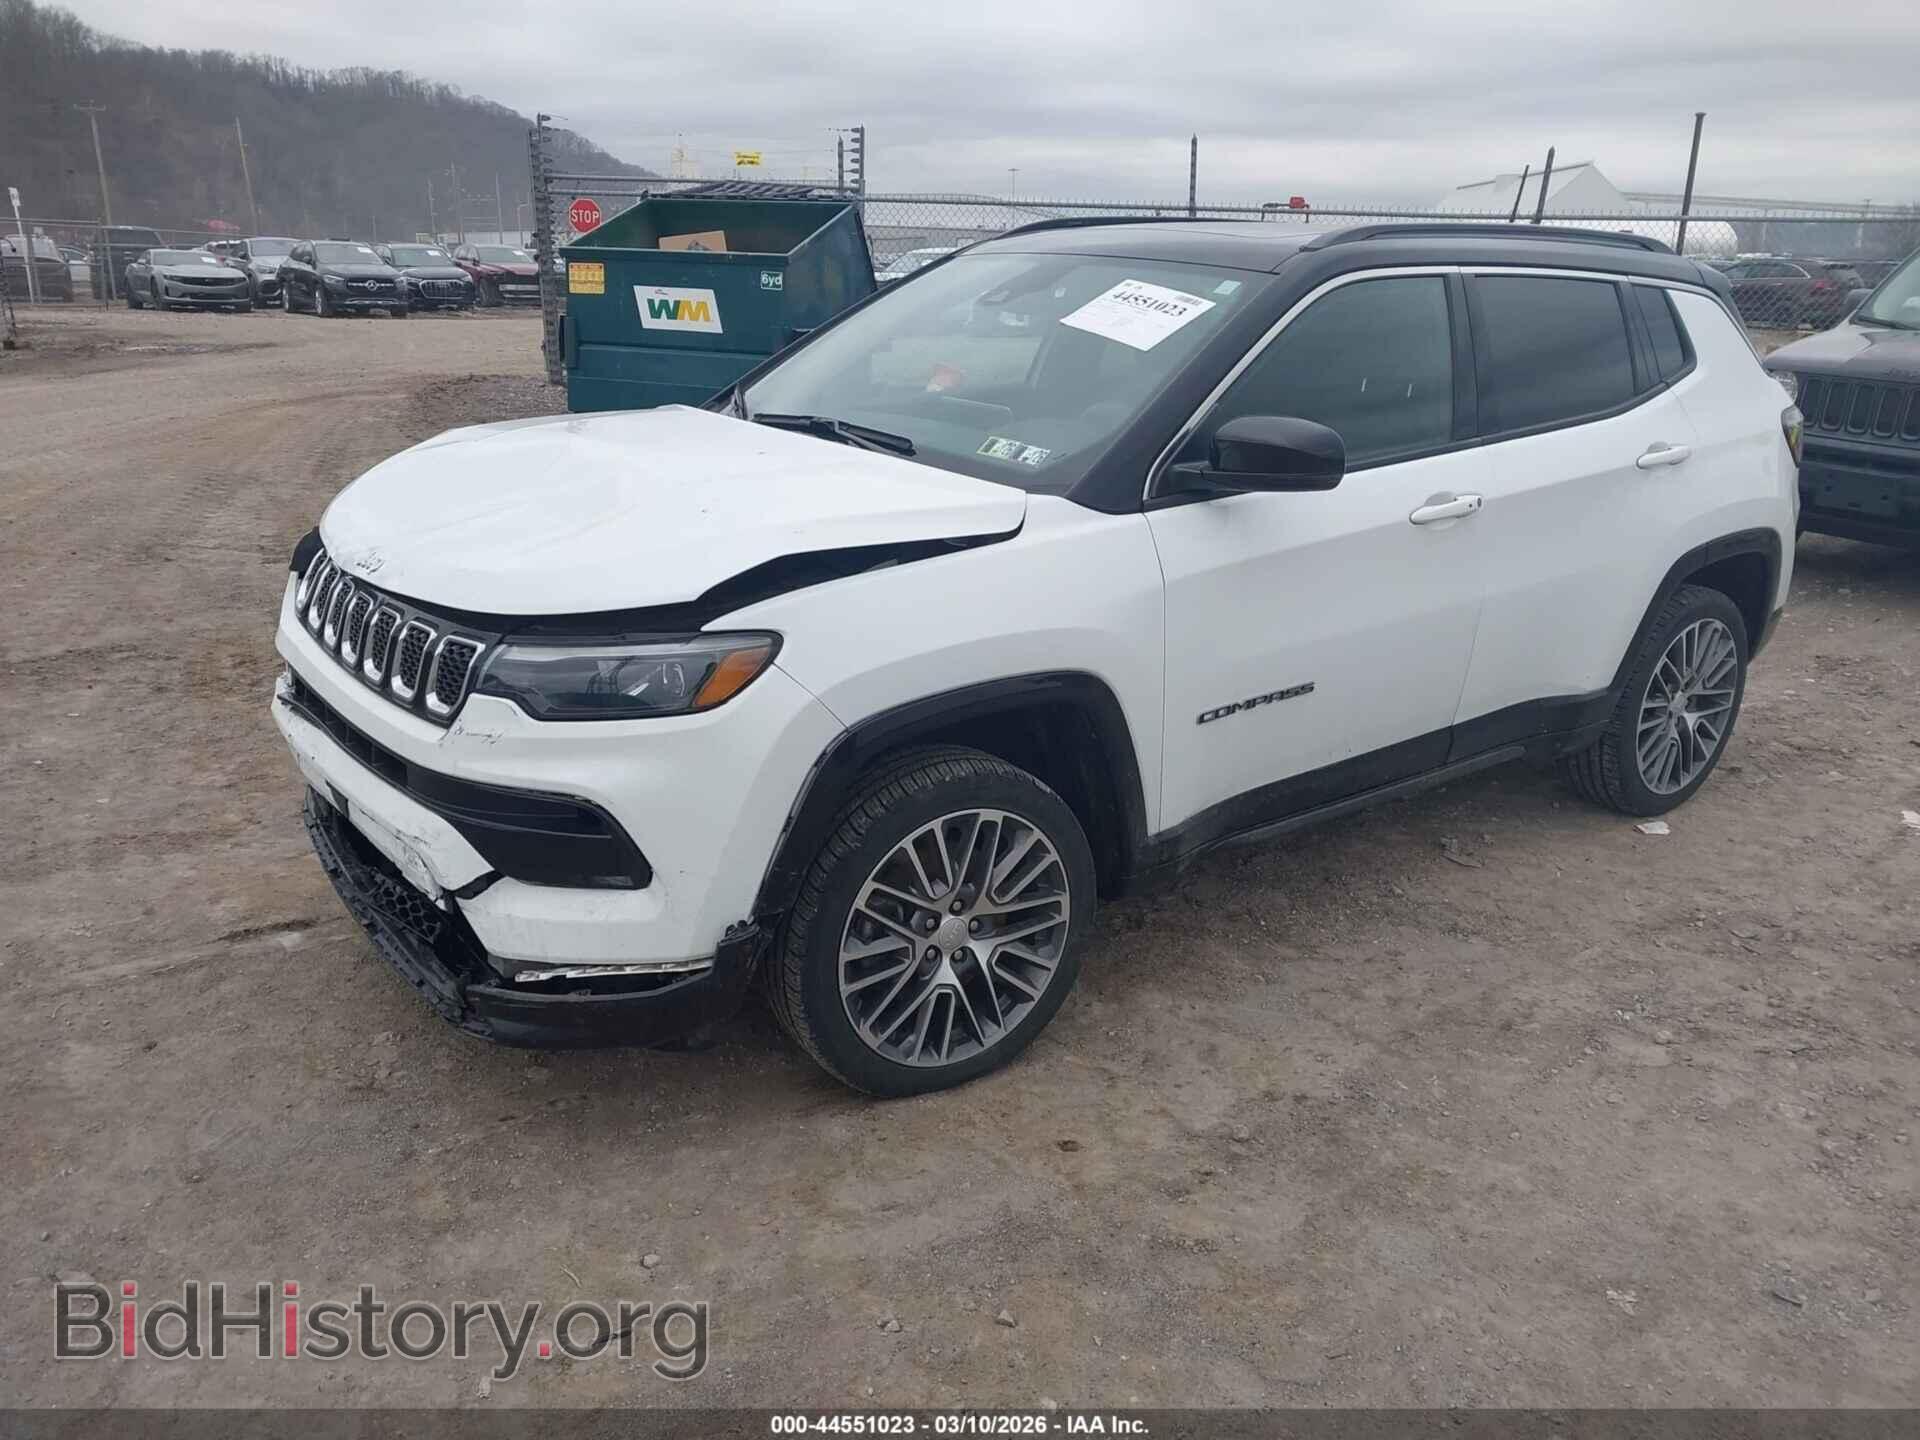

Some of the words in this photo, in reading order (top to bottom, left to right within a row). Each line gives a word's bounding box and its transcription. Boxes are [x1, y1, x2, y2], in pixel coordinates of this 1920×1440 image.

[571, 209, 600, 224] STOP
[761, 273, 783, 288] 6yd
[646, 298, 711, 322] WM
[1112, 290, 1188, 317] 44551023
[1196, 681, 1315, 725] COMPASS
